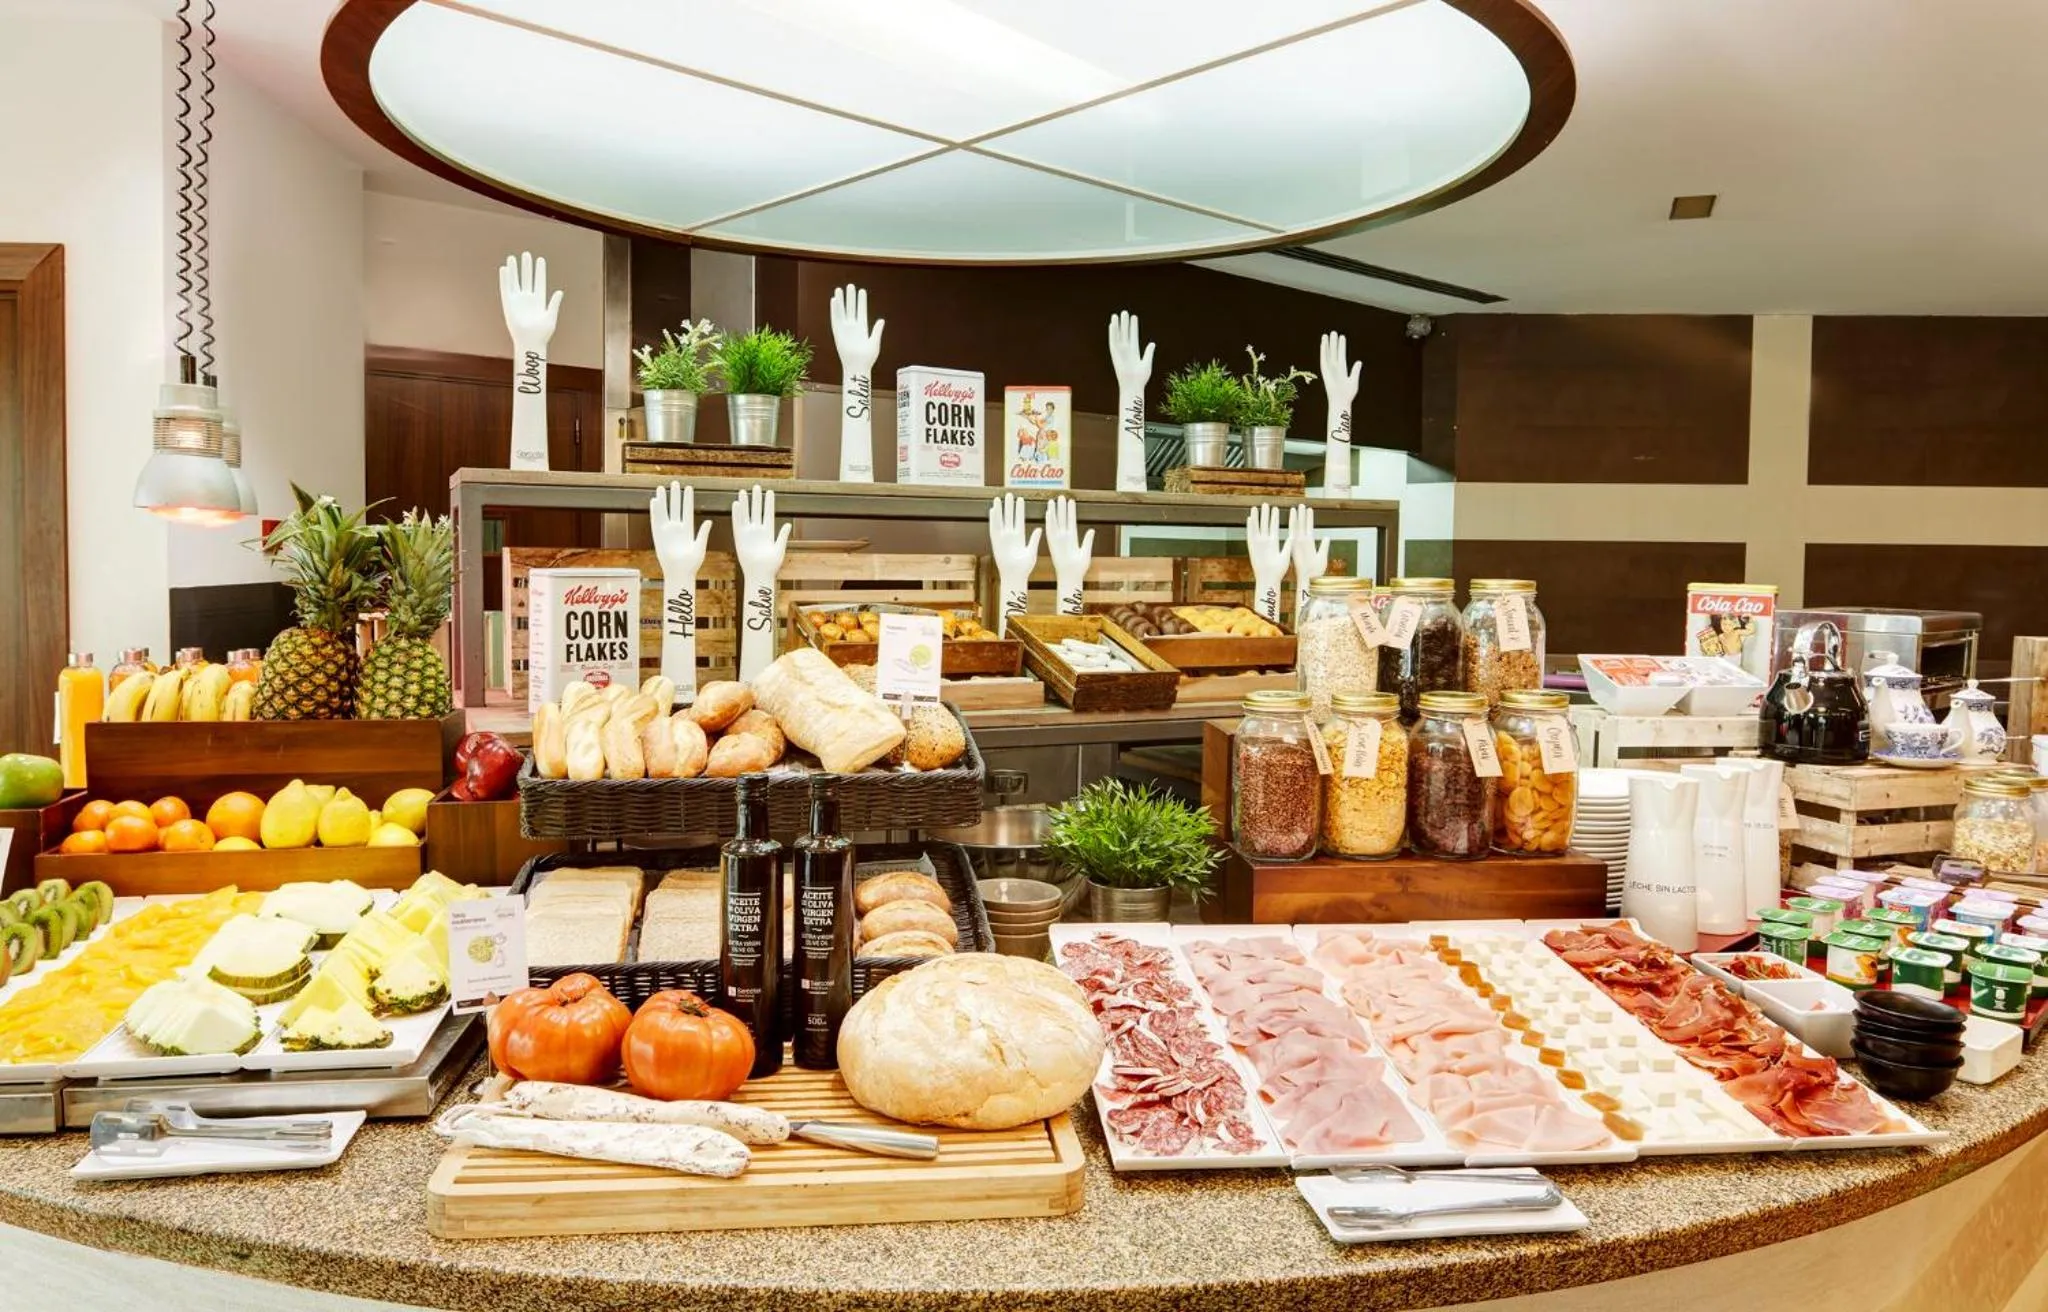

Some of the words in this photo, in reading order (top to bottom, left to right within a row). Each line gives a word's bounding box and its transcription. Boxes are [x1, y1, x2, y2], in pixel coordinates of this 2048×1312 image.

[846, 374, 871, 421] Salut
[924, 381, 976, 404] Kellogg's
[925, 401, 975, 428] CORN
[1124, 395, 1144, 442] Aloha
[925, 428, 975, 446] FLAKES
[1331, 410, 1351, 443] Ciao
[564, 584, 629, 609] Kellogg's
[667, 588, 694, 639] Hello
[747, 586, 773, 633] Salve
[566, 611, 628, 640] CORN
[566, 641, 628, 663] FLAKES
[729, 897, 760, 906] ACEITE
[802, 891, 833, 900] ACEITE
[808, 900, 834, 908] OLIVA
[728, 915, 760, 923] VIRGEN
[734, 906, 761, 914] OLIVA
[802, 908, 834, 917] VIRGEN
[803, 917, 832, 925] EXTRA
[730, 924, 759, 932] EXTRA
